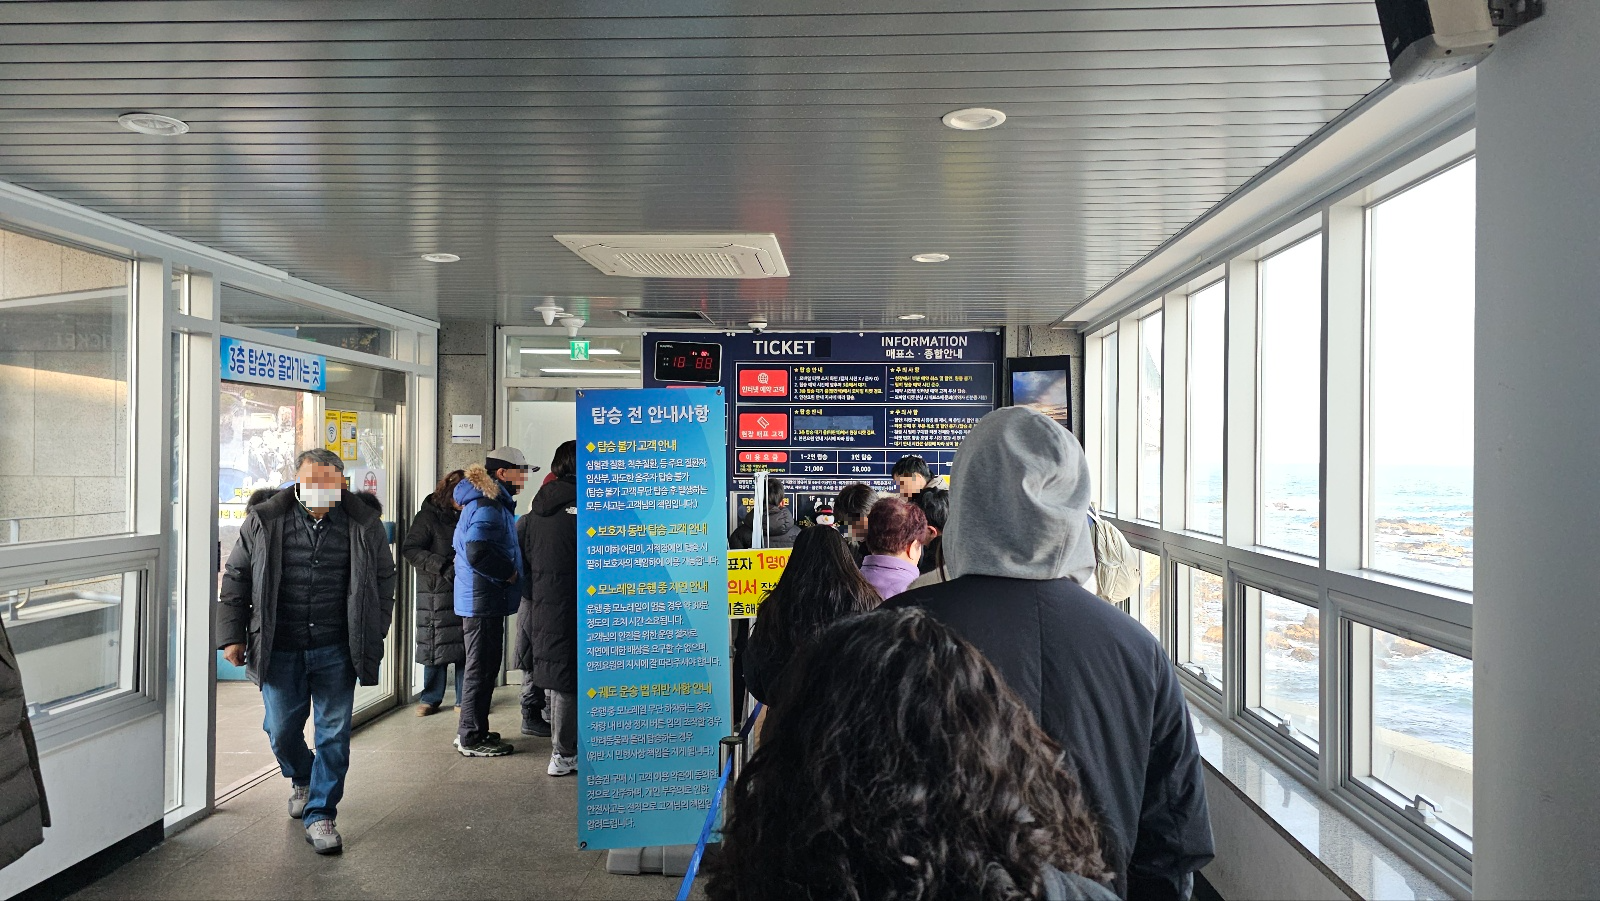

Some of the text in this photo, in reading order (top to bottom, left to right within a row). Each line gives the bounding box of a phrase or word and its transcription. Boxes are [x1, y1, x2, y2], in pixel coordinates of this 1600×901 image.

[753, 340, 815, 355] TICKET
[881, 336, 968, 347] INFORMATION
[886, 348, 963, 360] 매표소 종합안내
[230, 346, 320, 385] 3층 탑승장 올라가는 곳
[592, 404, 710, 425] 탑승 전 안내사항
[597, 439, 677, 453] 탑승 불가 고객 안내
[586, 460, 609, 471] 심혈관
[610, 460, 627, 470] 질환,
[660, 458, 668, 469] 등
[685, 457, 707, 468] 질환자
[586, 471, 690, 484] 임산부, 과도한 음주자 탑승 불가
[586, 485, 708, 498] (탑승 불가 고객 무단 탑승 후 발생하는
[586, 501, 602, 511] 모든
[603, 500, 626, 511] 사고는
[626, 499, 656, 510] 고객님의
[597, 522, 708, 537] 보호자 동반 탑승 고객 안내
[587, 544, 604, 556] 13세
[604, 544, 620, 555] 이하
[621, 543, 646, 554] 어린이,
[685, 542, 700, 552] 탑승
[701, 542, 708, 552] 시
[586, 559, 602, 570] 필히
[603, 558, 633, 569] 보호자의
[634, 557, 665, 568] 책임하에
[665, 557, 680, 567] 이용
[598, 580, 708, 596] 모노레일 운행 중 지연 안내
[612, 602, 650, 612] 모노레일이
[667, 600, 682, 611] 경우
[684, 600, 692, 611] 약
[586, 614, 684, 629] 정도의 조치 시간 소요됩니다.
[586, 631, 617, 642] 고객님의
[618, 630, 641, 641] 안전을
[642, 629, 657, 640] 위한
[675, 628, 698, 639] 절차로
[586, 646, 610, 657] 지연에
[610, 645, 626, 656] 대한
[627, 644, 650, 655] 배상을
[651, 643, 674, 654] 요구할
[675, 643, 683, 653] 수
[586, 660, 625, 672] 안전요원의
[626, 659, 649, 670] 지시에
[650, 658, 658, 669] 잘
[597, 685, 618, 698] 궤도
[652, 683, 671, 696] 위반
[672, 682, 692, 696] 사항
[692, 682, 712, 695] 안내
[617, 704, 647, 716] 모노레일
[648, 703, 664, 715] 무단
[664, 702, 695, 714] 하차하는
[696, 701, 712, 712] 경우
[590, 720, 607, 732] 차량
[633, 718, 649, 730] 정지
[706, 715, 722, 727] 경우
[646, 732, 678, 744] 탑승하는
[679, 731, 694, 743] 경우
[606, 749, 614, 760] 시
[646, 747, 670, 759] 책임을
[587, 774, 611, 786] 탑승권
[612, 773, 627, 785] 구매
[628, 772, 637, 784] 시
[638, 771, 654, 783] 고객
[654, 770, 670, 782] 이용
[695, 768, 719, 780] 동의한
[586, 783, 709, 801] 것으로 간주하며, 개인 부주의로 인한
[586, 803, 626, 816] 안전사고는
[627, 801, 657, 813] 전적으로
[586, 817, 636, 831] 알려드립니다.
